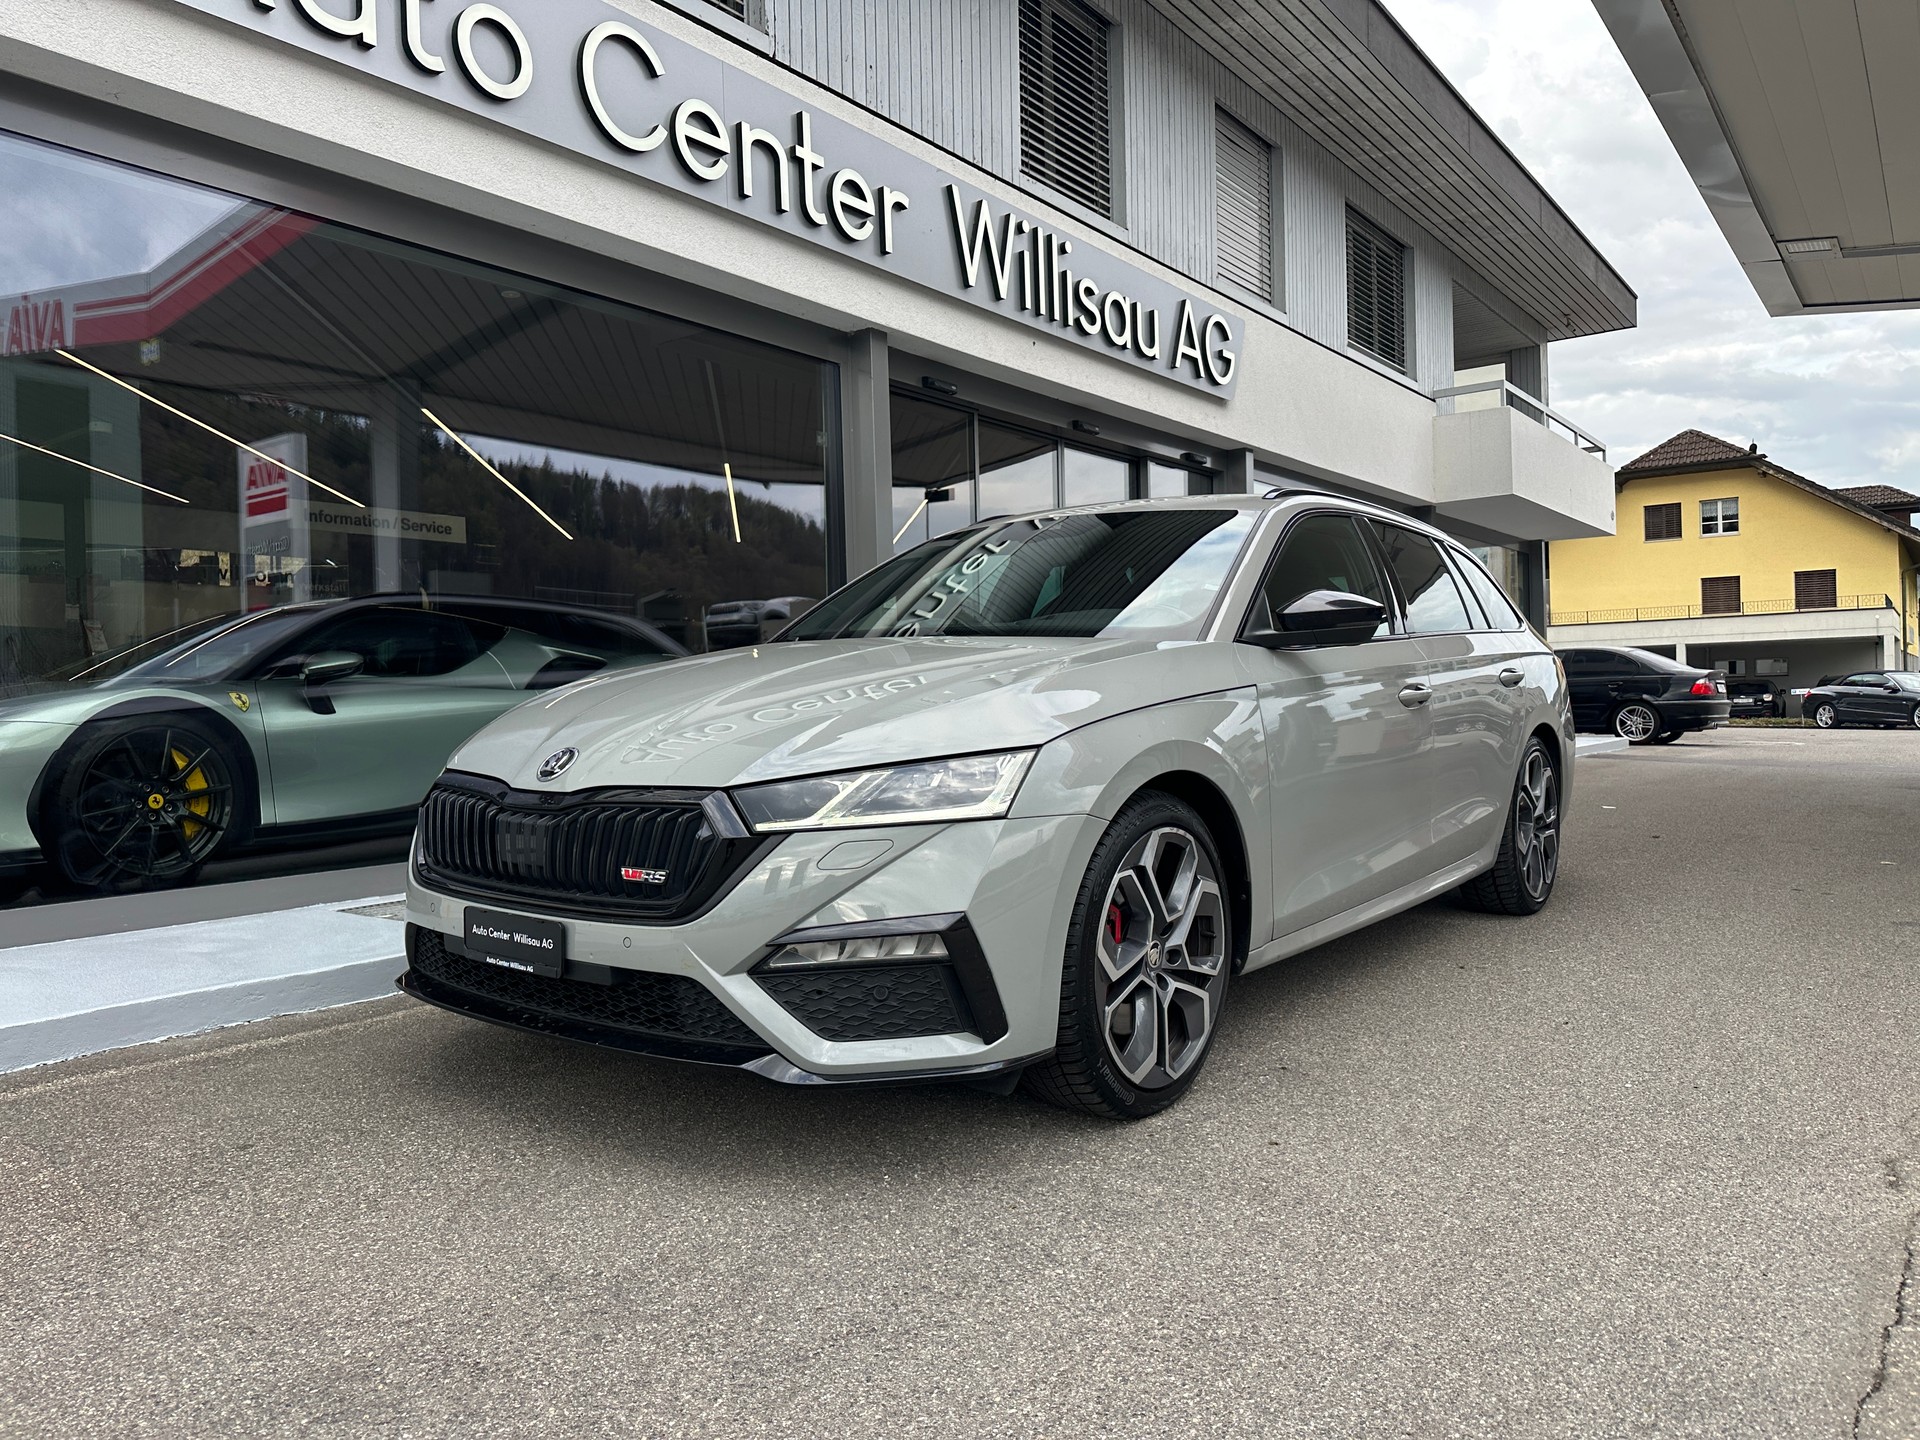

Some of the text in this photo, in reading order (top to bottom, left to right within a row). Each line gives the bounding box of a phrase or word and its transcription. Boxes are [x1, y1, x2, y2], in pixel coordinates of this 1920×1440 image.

[578, 20, 909, 255] Center
[946, 183, 1160, 360] Willisau
[1170, 298, 1236, 386] AG
[304, 508, 390, 529] Information
[401, 518, 452, 535] Service
[472, 924, 553, 949] Auto Center Willisau AG
[486, 956, 534, 973] Auto Center Willisau AG
